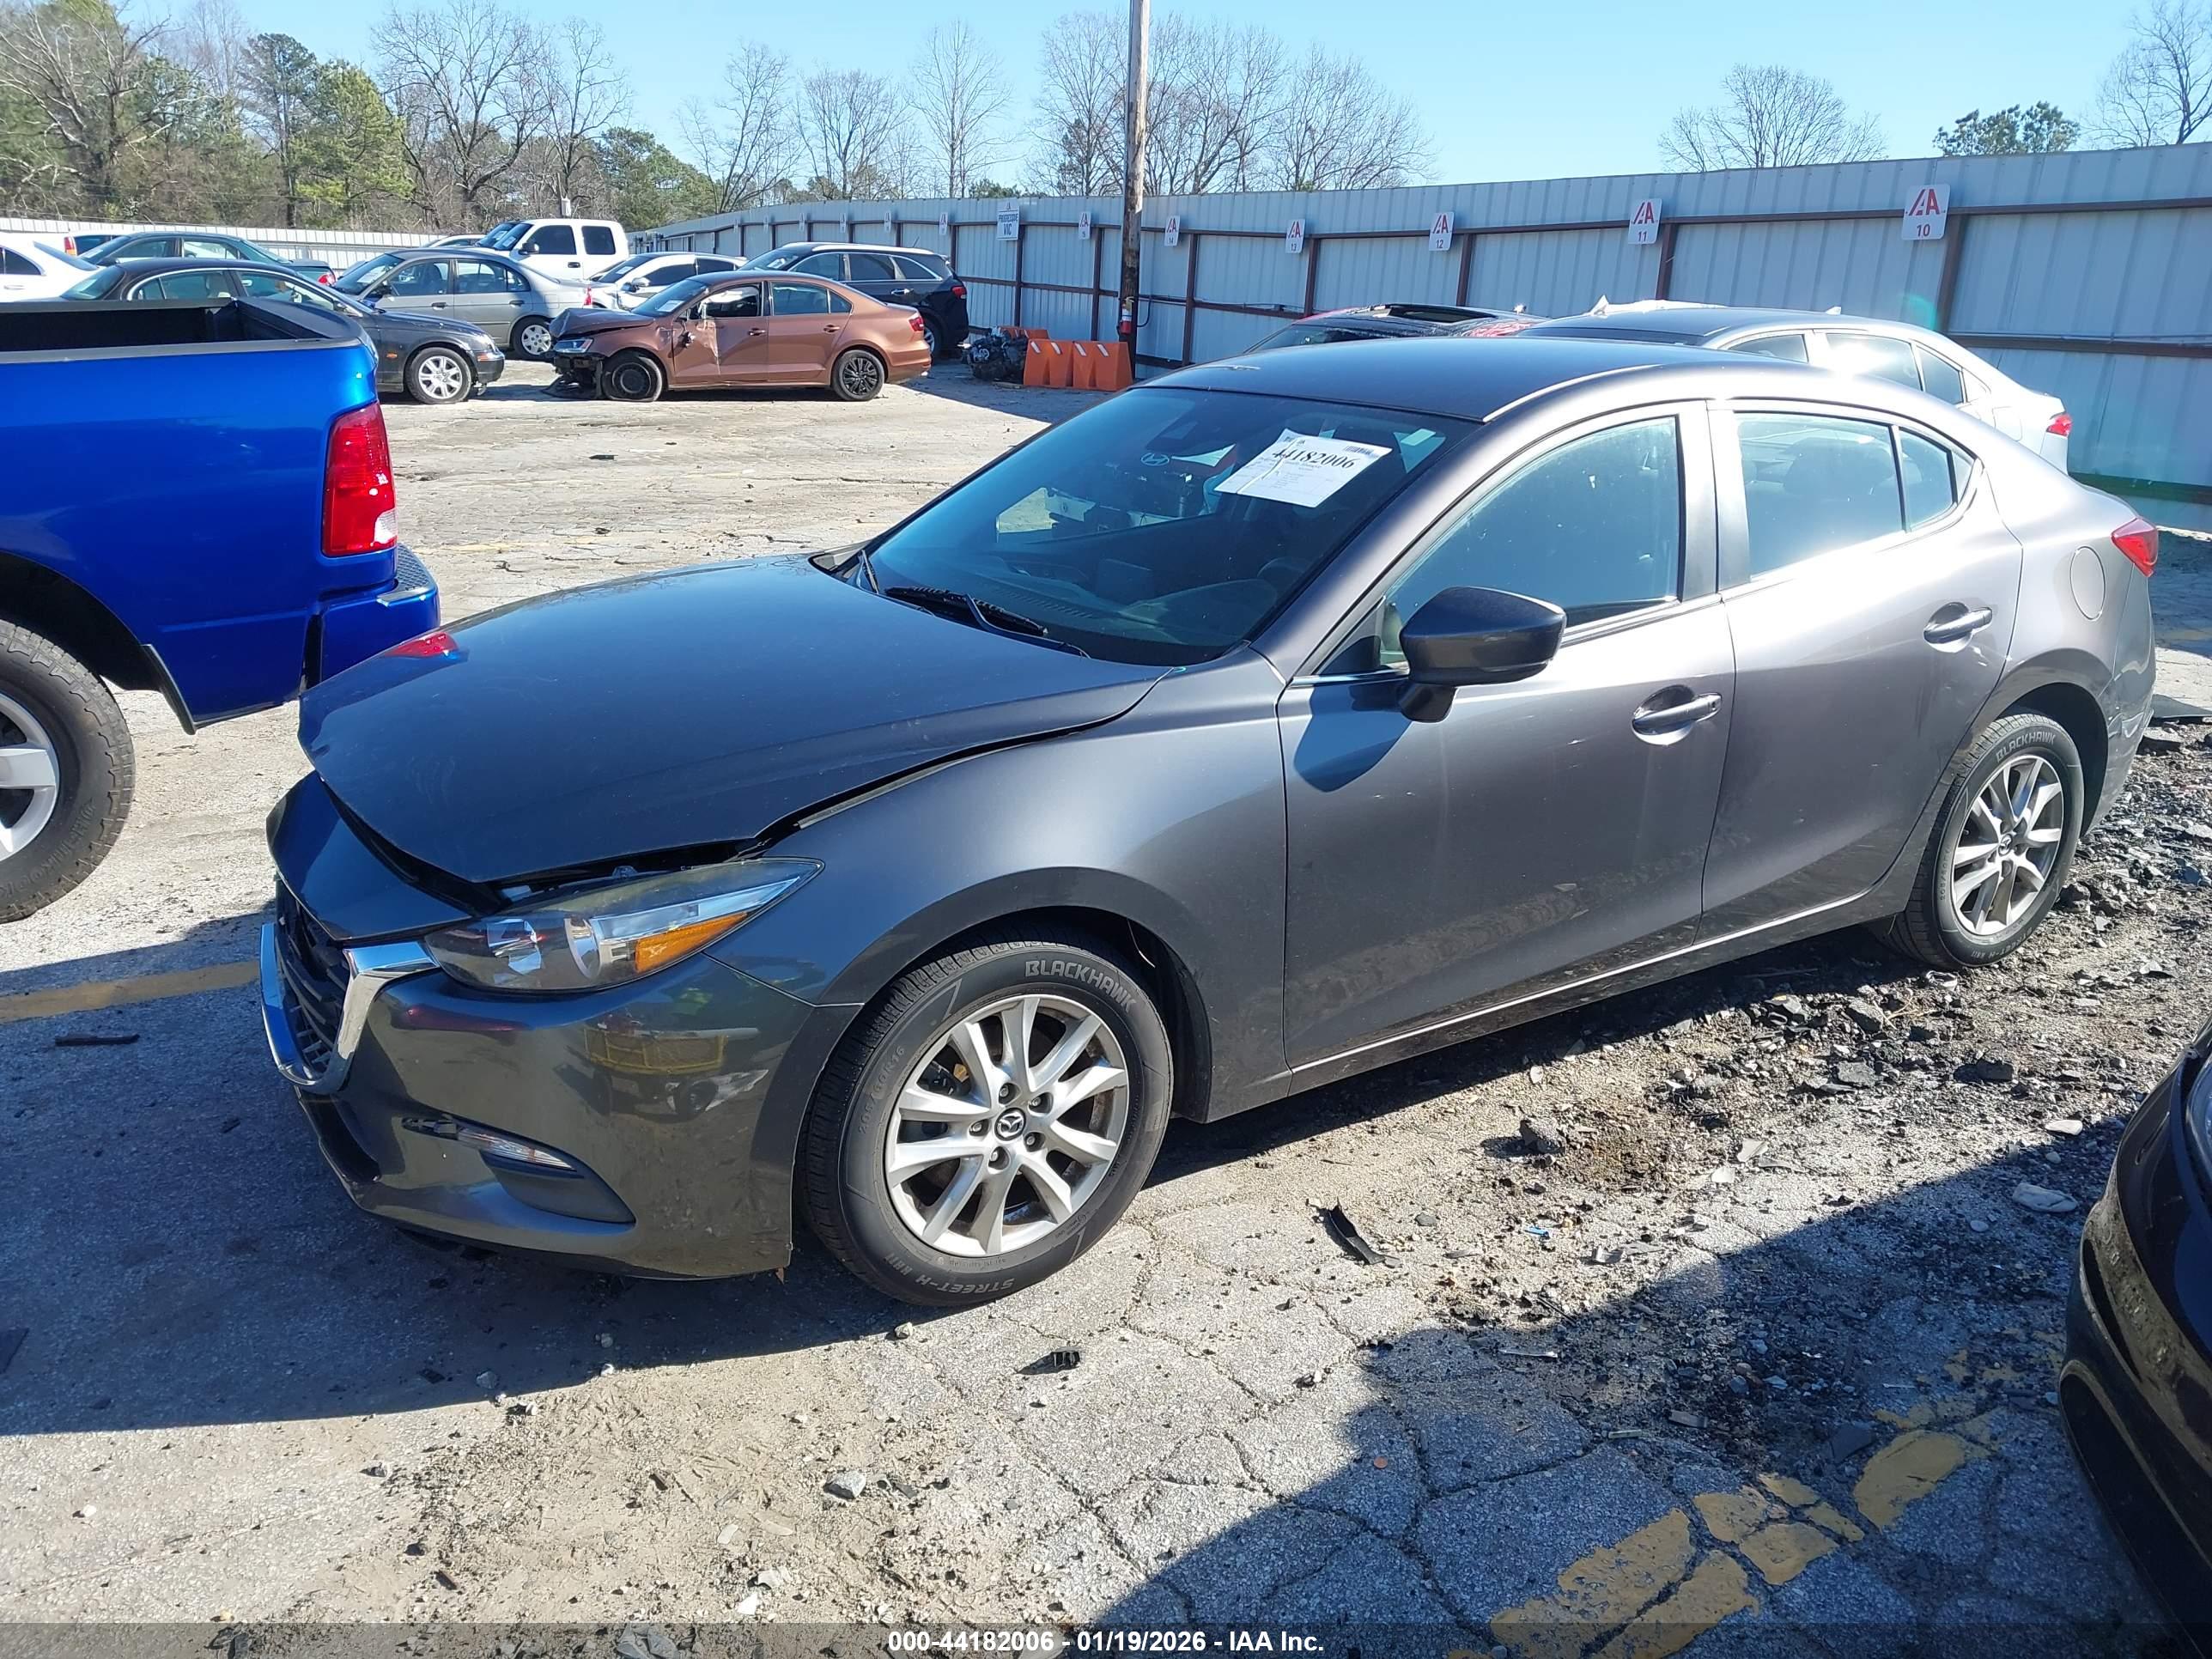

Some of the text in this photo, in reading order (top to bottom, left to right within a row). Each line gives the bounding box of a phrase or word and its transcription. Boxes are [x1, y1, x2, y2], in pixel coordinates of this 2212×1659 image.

[1637, 230, 1648, 242] 11
[1916, 222, 1930, 238] 10
[1436, 239, 1444, 249] 12
[1996, 731, 2057, 763] BLACKHAWK
[1024, 959, 1138, 1014] BLACKHAWK
[915, 1273, 1015, 1294] STREET-H
